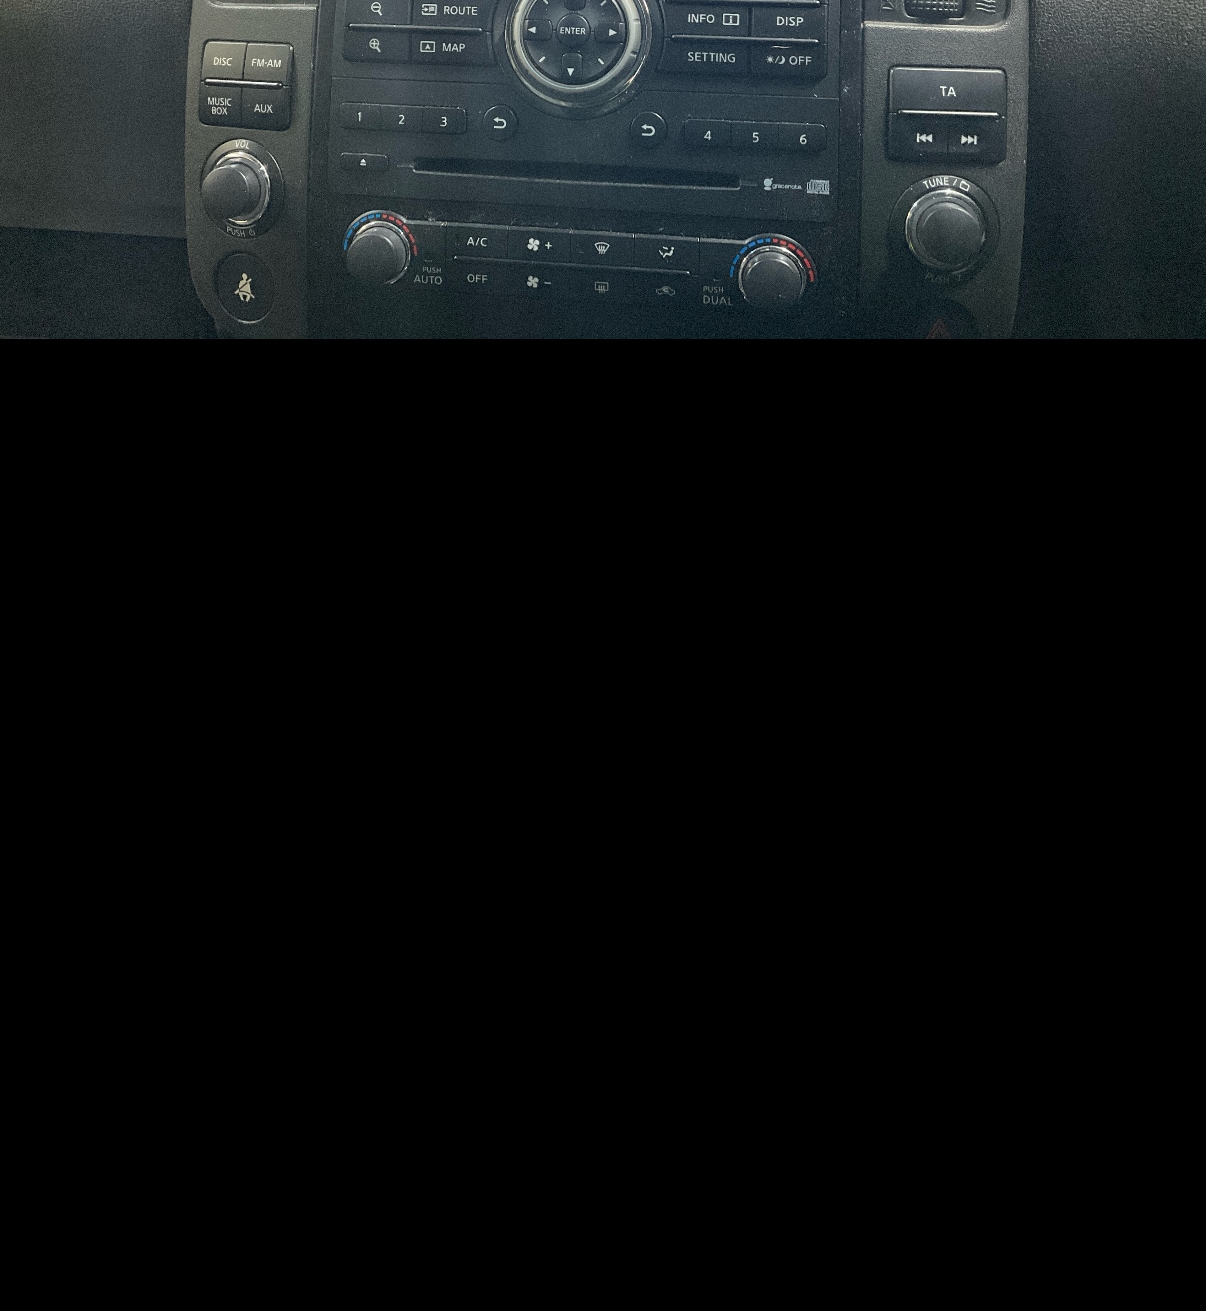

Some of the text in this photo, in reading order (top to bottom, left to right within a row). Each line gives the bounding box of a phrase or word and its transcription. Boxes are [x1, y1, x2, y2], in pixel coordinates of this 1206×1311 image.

[443, 5, 478, 16] ROUTE
[687, 13, 715, 24] INFO
[776, 16, 804, 27] DISP
[559, 26, 586, 35] ENTER
[442, 42, 466, 53] MAP
[213, 56, 233, 67] DISC
[687, 51, 736, 63] SETTING
[789, 56, 812, 66] OFF
[939, 85, 957, 97] TA
[207, 97, 232, 107] MUSIC
[211, 106, 228, 116] BOX
[254, 103, 273, 114] AUX
[357, 112, 363, 122] 1
[398, 115, 405, 125] 2
[439, 117, 448, 127] 3
[703, 130, 712, 141] 4
[752, 132, 760, 143] 5
[799, 134, 808, 145] 6
[235, 140, 250, 150] VOL
[923, 176, 950, 189] TUNE
[226, 226, 246, 238] PUSH
[467, 236, 488, 248] A/C
[422, 266, 442, 274] PUSH
[414, 274, 443, 285] AUTO
[467, 273, 488, 284] OFF
[702, 286, 724, 295] PUSH
[702, 295, 733, 306] DUAL
